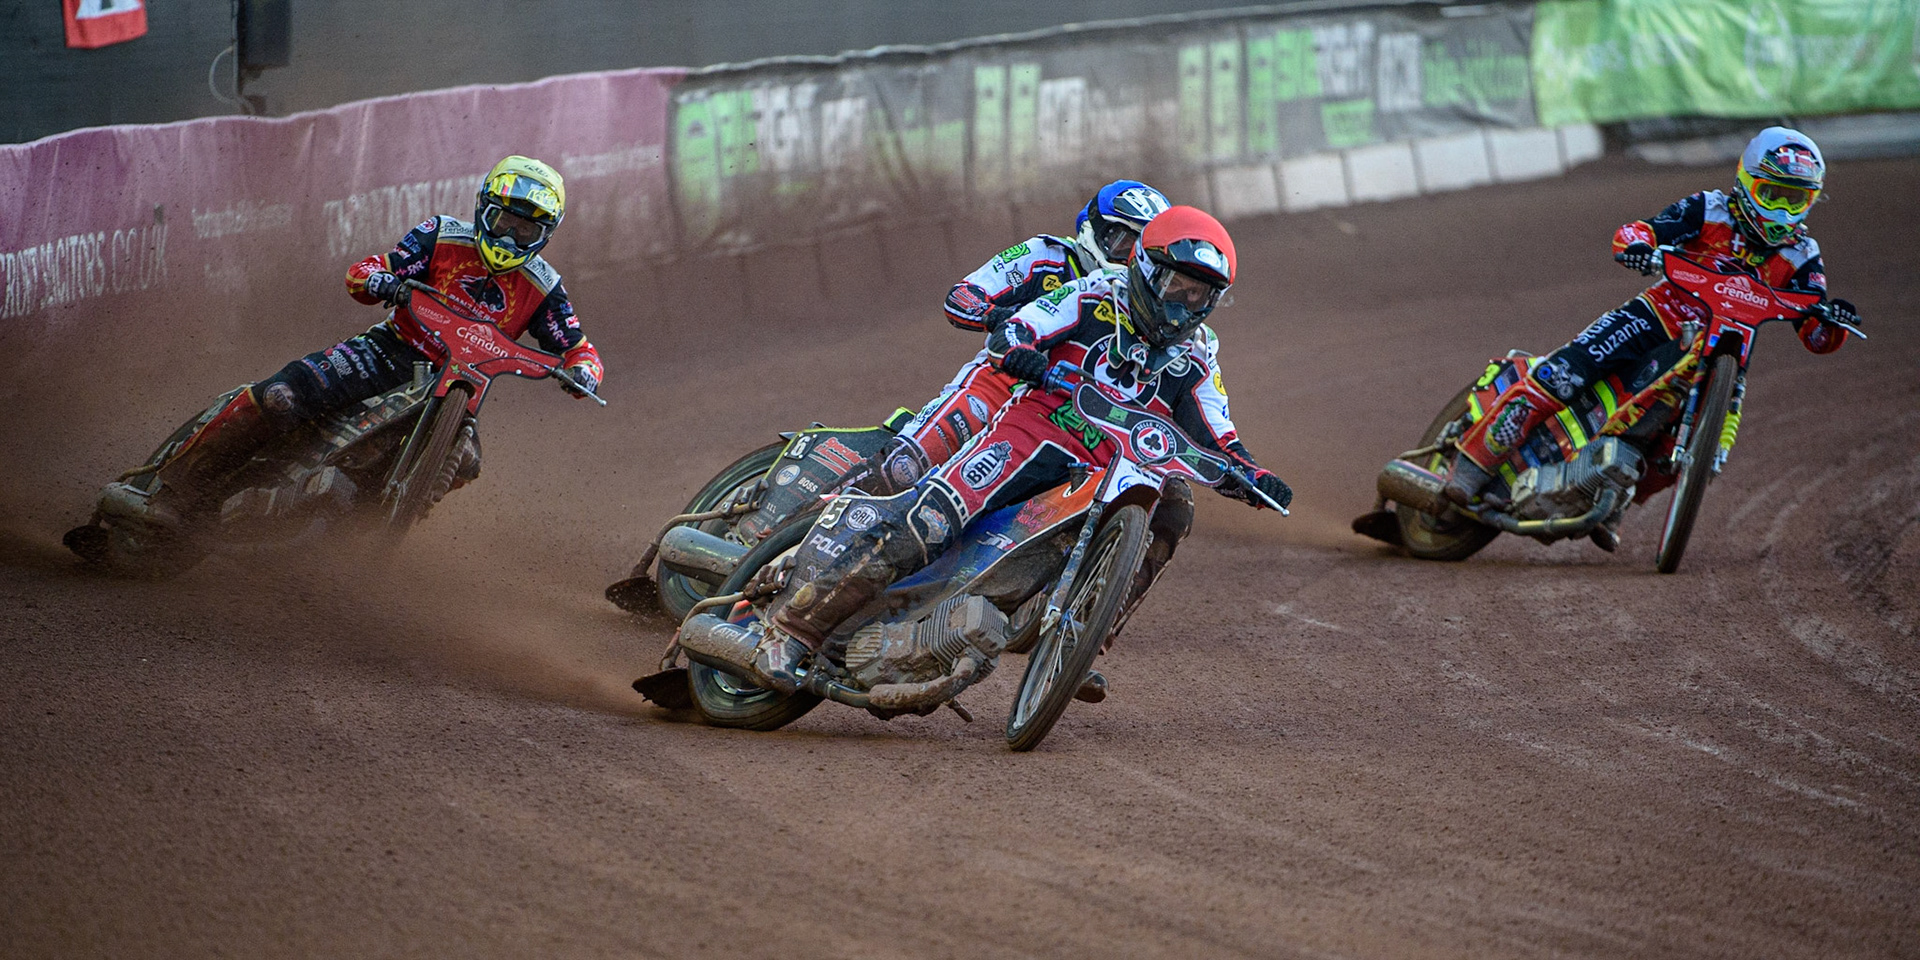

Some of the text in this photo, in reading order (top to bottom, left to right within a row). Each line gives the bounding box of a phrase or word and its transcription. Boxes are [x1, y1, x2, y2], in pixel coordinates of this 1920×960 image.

[1713, 281, 1769, 308] Crendon
[456, 326, 509, 359] Crendon
[791, 435, 811, 456] 6
[797, 476, 819, 493] BOSS
